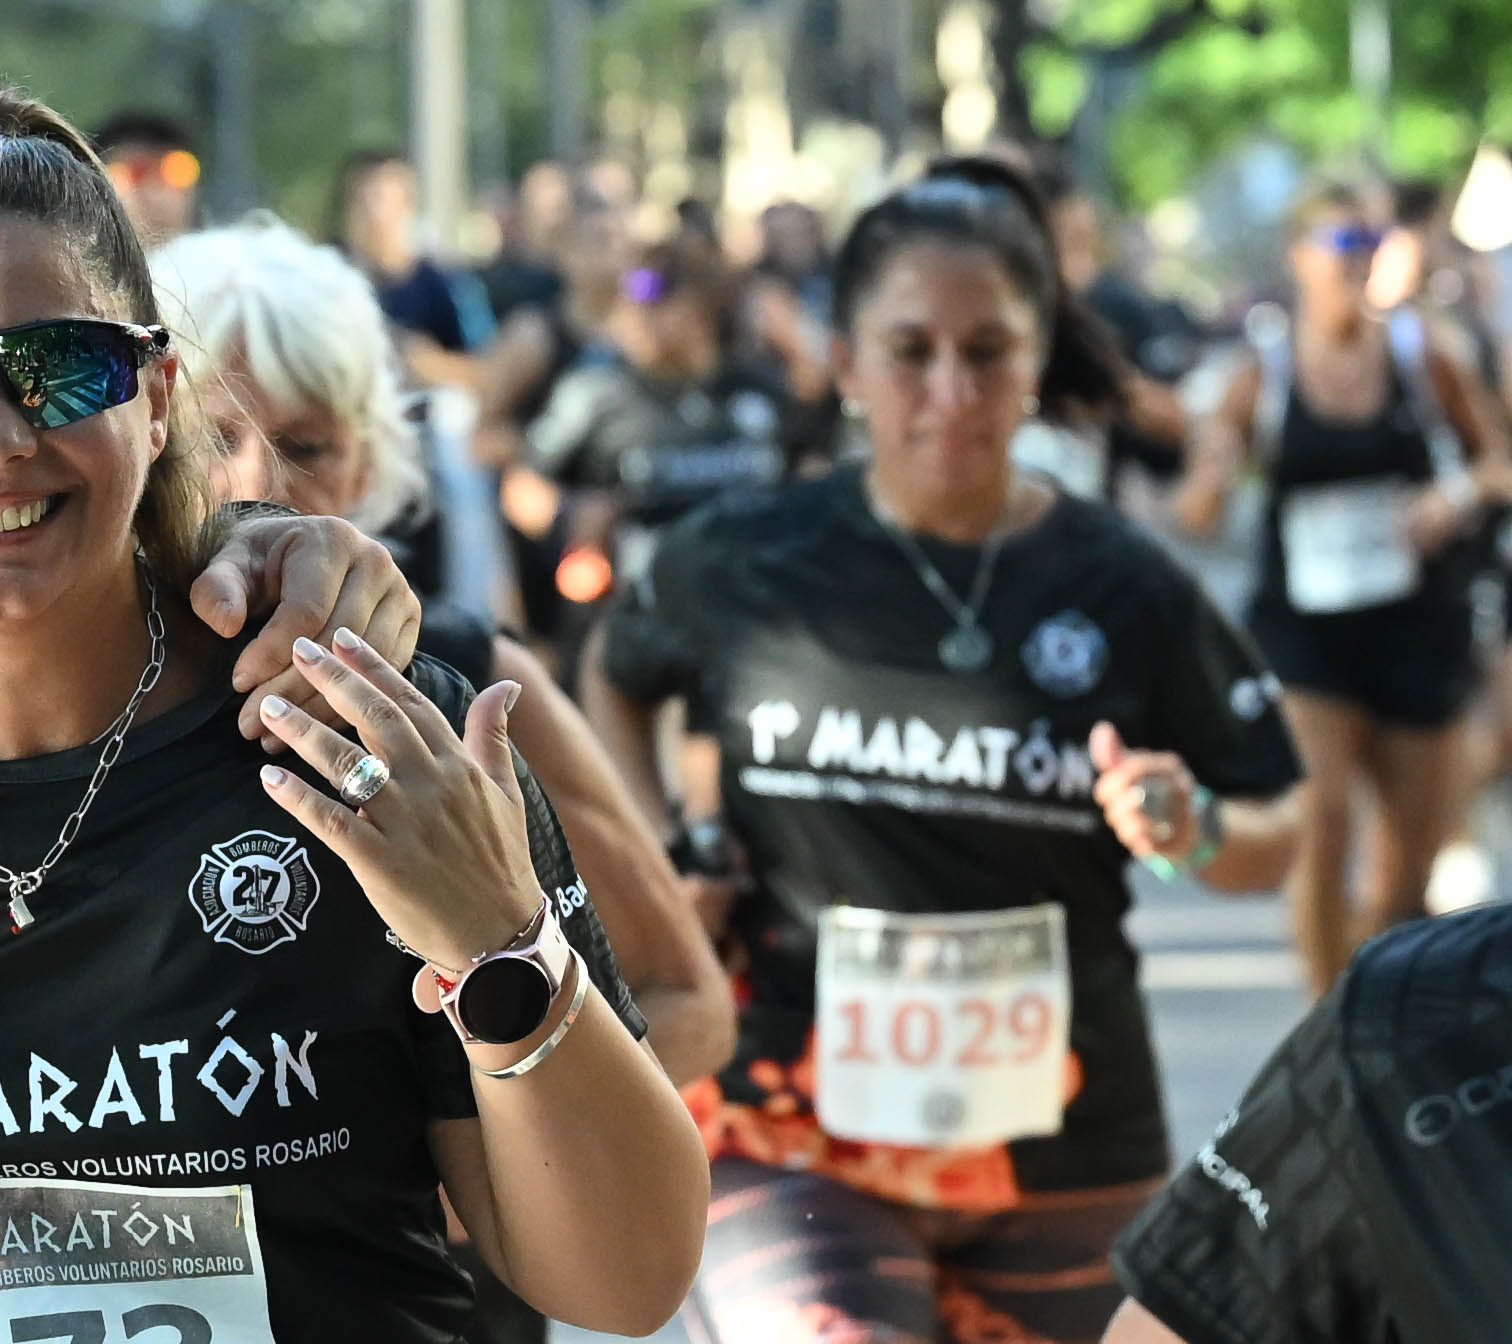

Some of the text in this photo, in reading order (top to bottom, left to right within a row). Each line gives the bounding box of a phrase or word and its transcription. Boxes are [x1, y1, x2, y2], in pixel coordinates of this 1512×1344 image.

[228, 840, 280, 858] BOMBEROS
[232, 865, 281, 907] 27
[235, 925, 276, 942] ROSARIO
[833, 993, 1053, 1068] 1029
[62, 1147, 247, 1176] VOLUNTARIOS
[255, 1127, 350, 1169] ROSARIO
[60, 1257, 168, 1282] VOLUNTARIOS
[172, 1256, 245, 1274] ROSARIO
